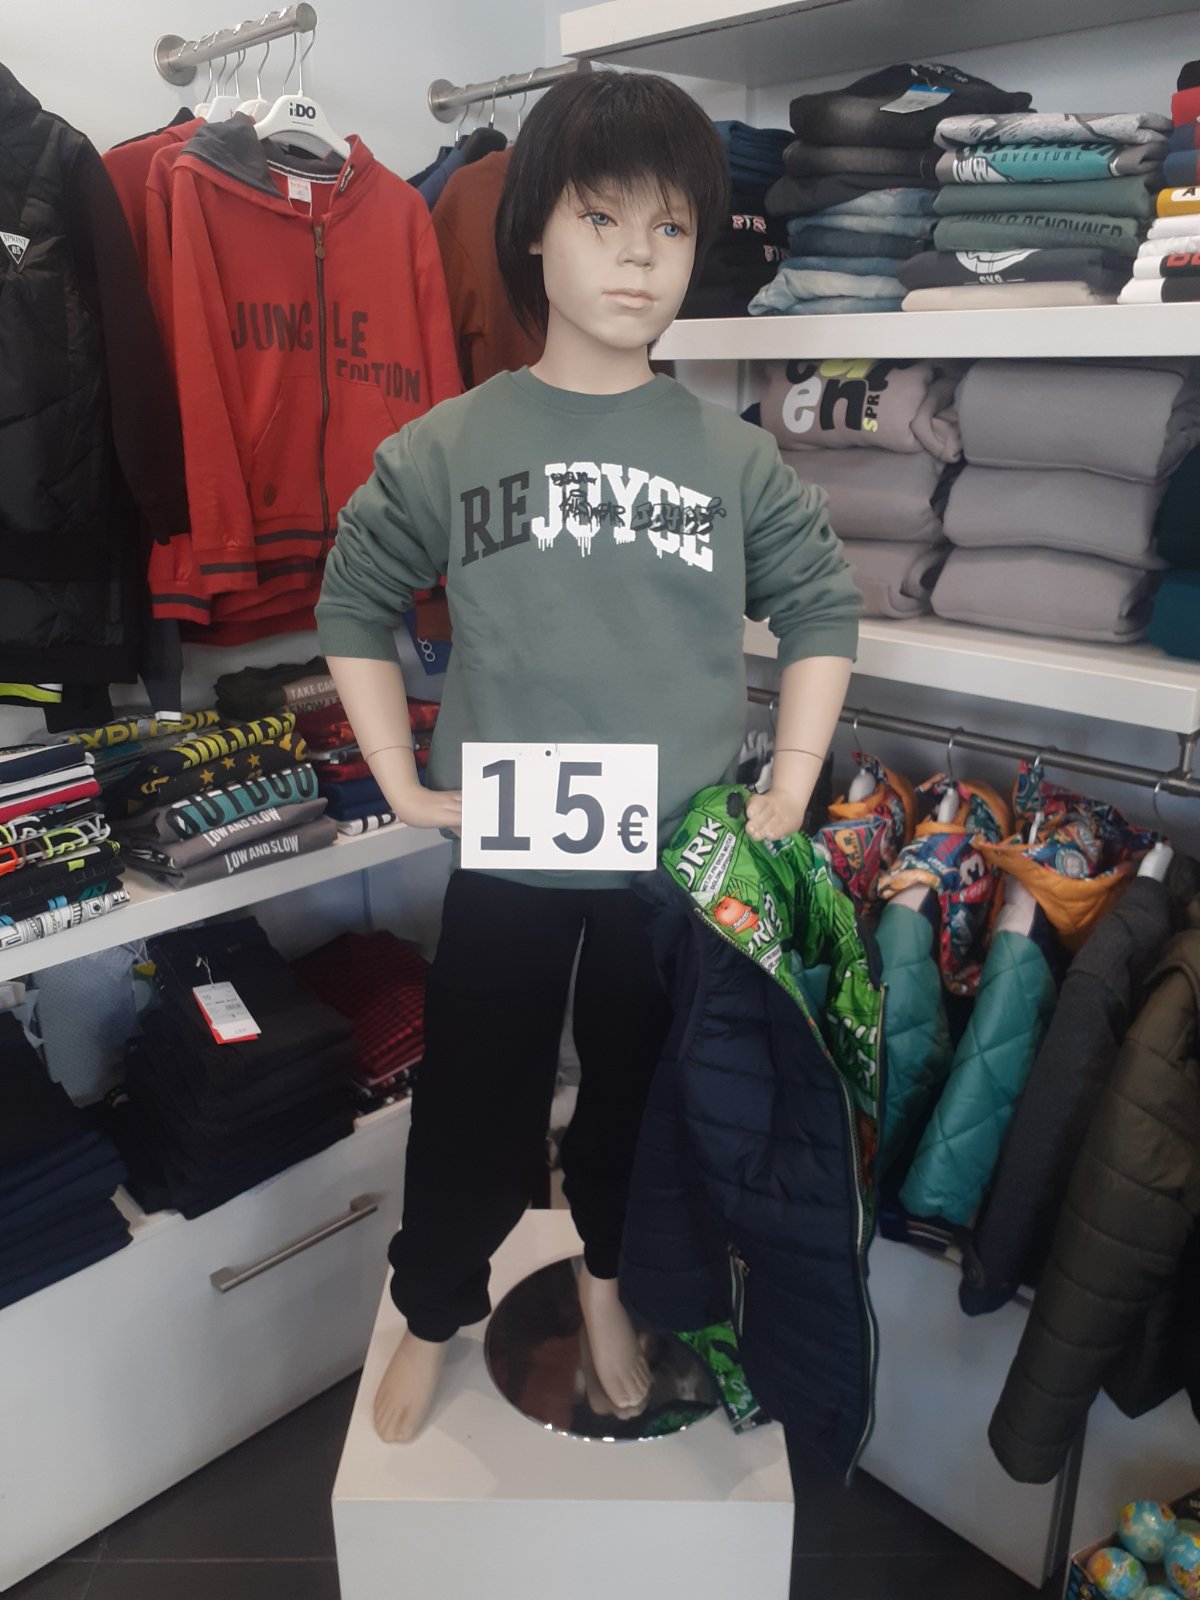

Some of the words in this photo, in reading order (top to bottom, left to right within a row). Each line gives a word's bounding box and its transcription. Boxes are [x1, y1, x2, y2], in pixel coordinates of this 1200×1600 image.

[991, 151, 1082, 163] ADVENTURE
[203, 827, 228, 848] LOW
[227, 819, 250, 837] AND
[250, 806, 281, 826] SLOW
[225, 848, 249, 874] LOW
[249, 844, 271, 861] AND
[271, 834, 299, 854] SLOW
